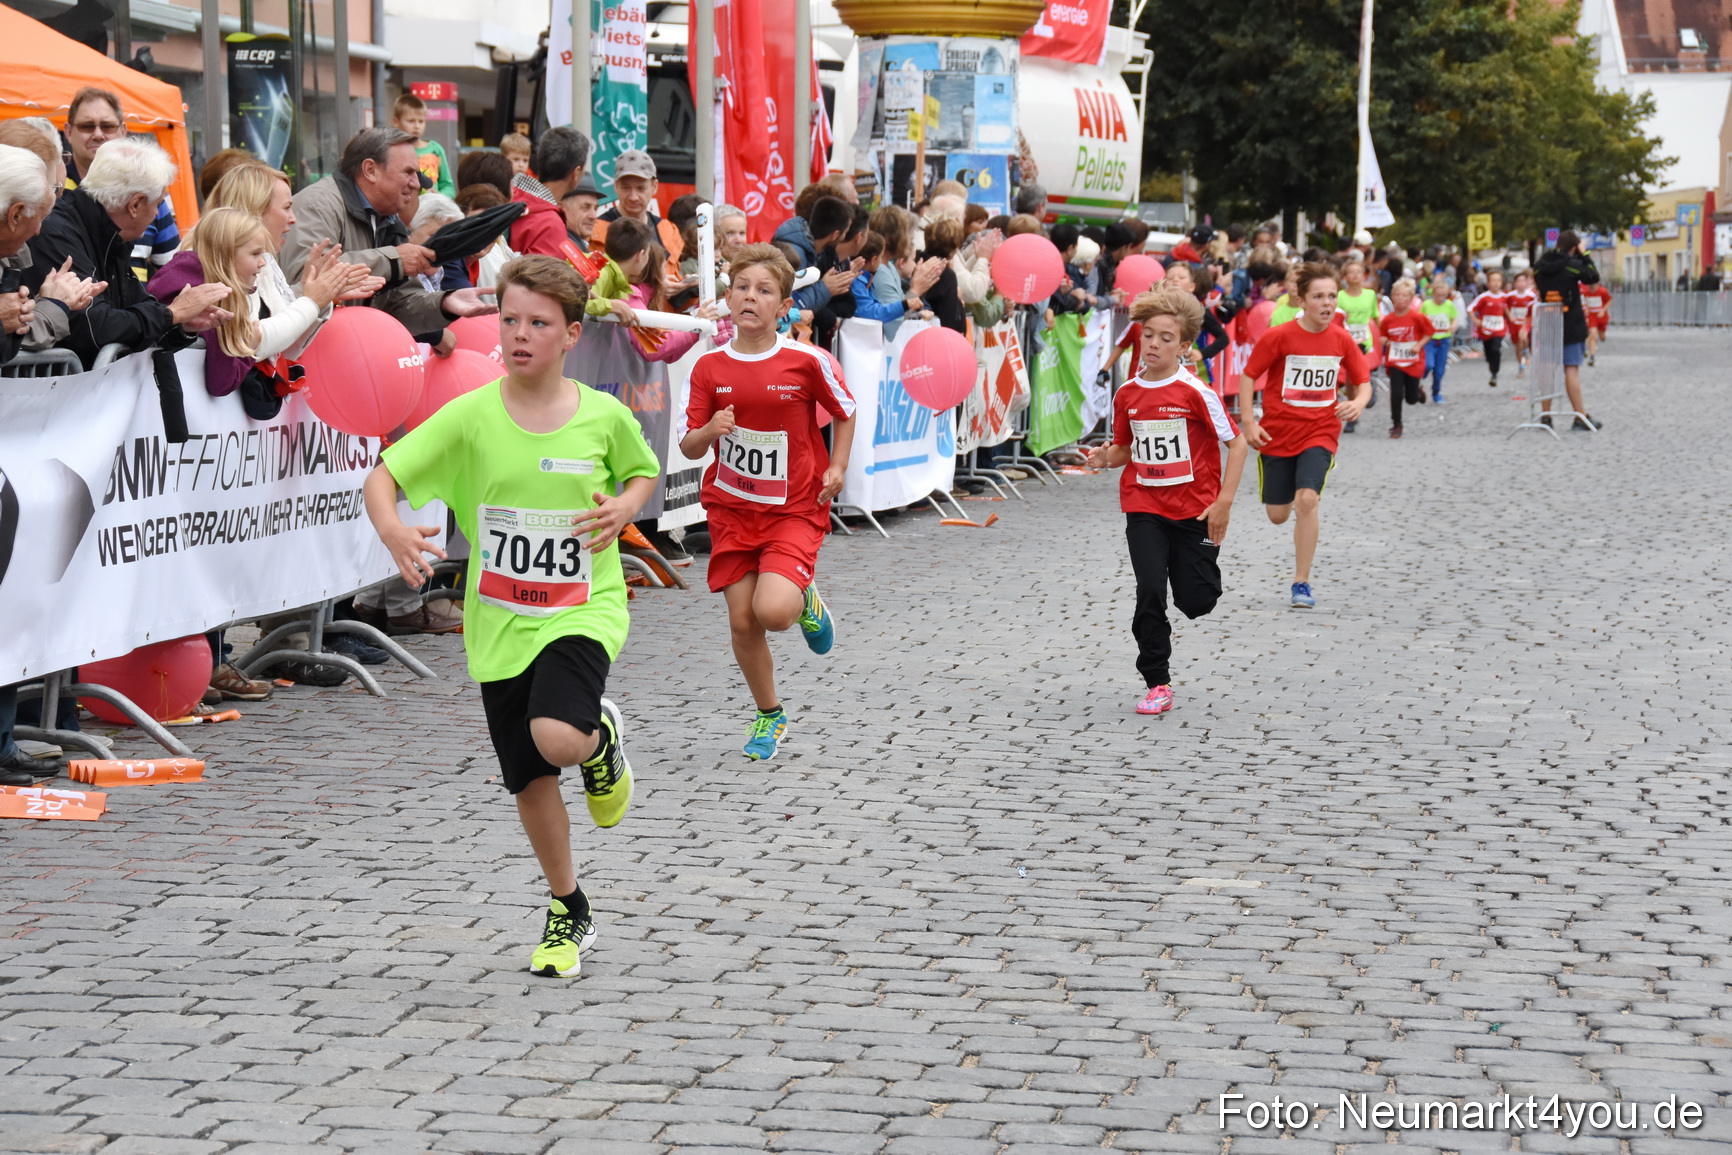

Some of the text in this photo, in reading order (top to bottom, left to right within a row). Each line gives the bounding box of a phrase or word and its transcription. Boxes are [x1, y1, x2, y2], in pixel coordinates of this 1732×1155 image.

[249, 50, 275, 63] cep
[946, 50, 980, 60] CHRISTIAN
[1072, 145, 1127, 192] Pellets
[1475, 225, 1486, 241] D
[1291, 367, 1336, 388] 7050
[724, 436, 778, 477] 7201
[1147, 467, 1166, 477] Max
[737, 477, 756, 492] Erik
[485, 516, 519, 527] NeuerMarkt
[489, 529, 581, 578] 7043
[512, 583, 549, 604] Leon
